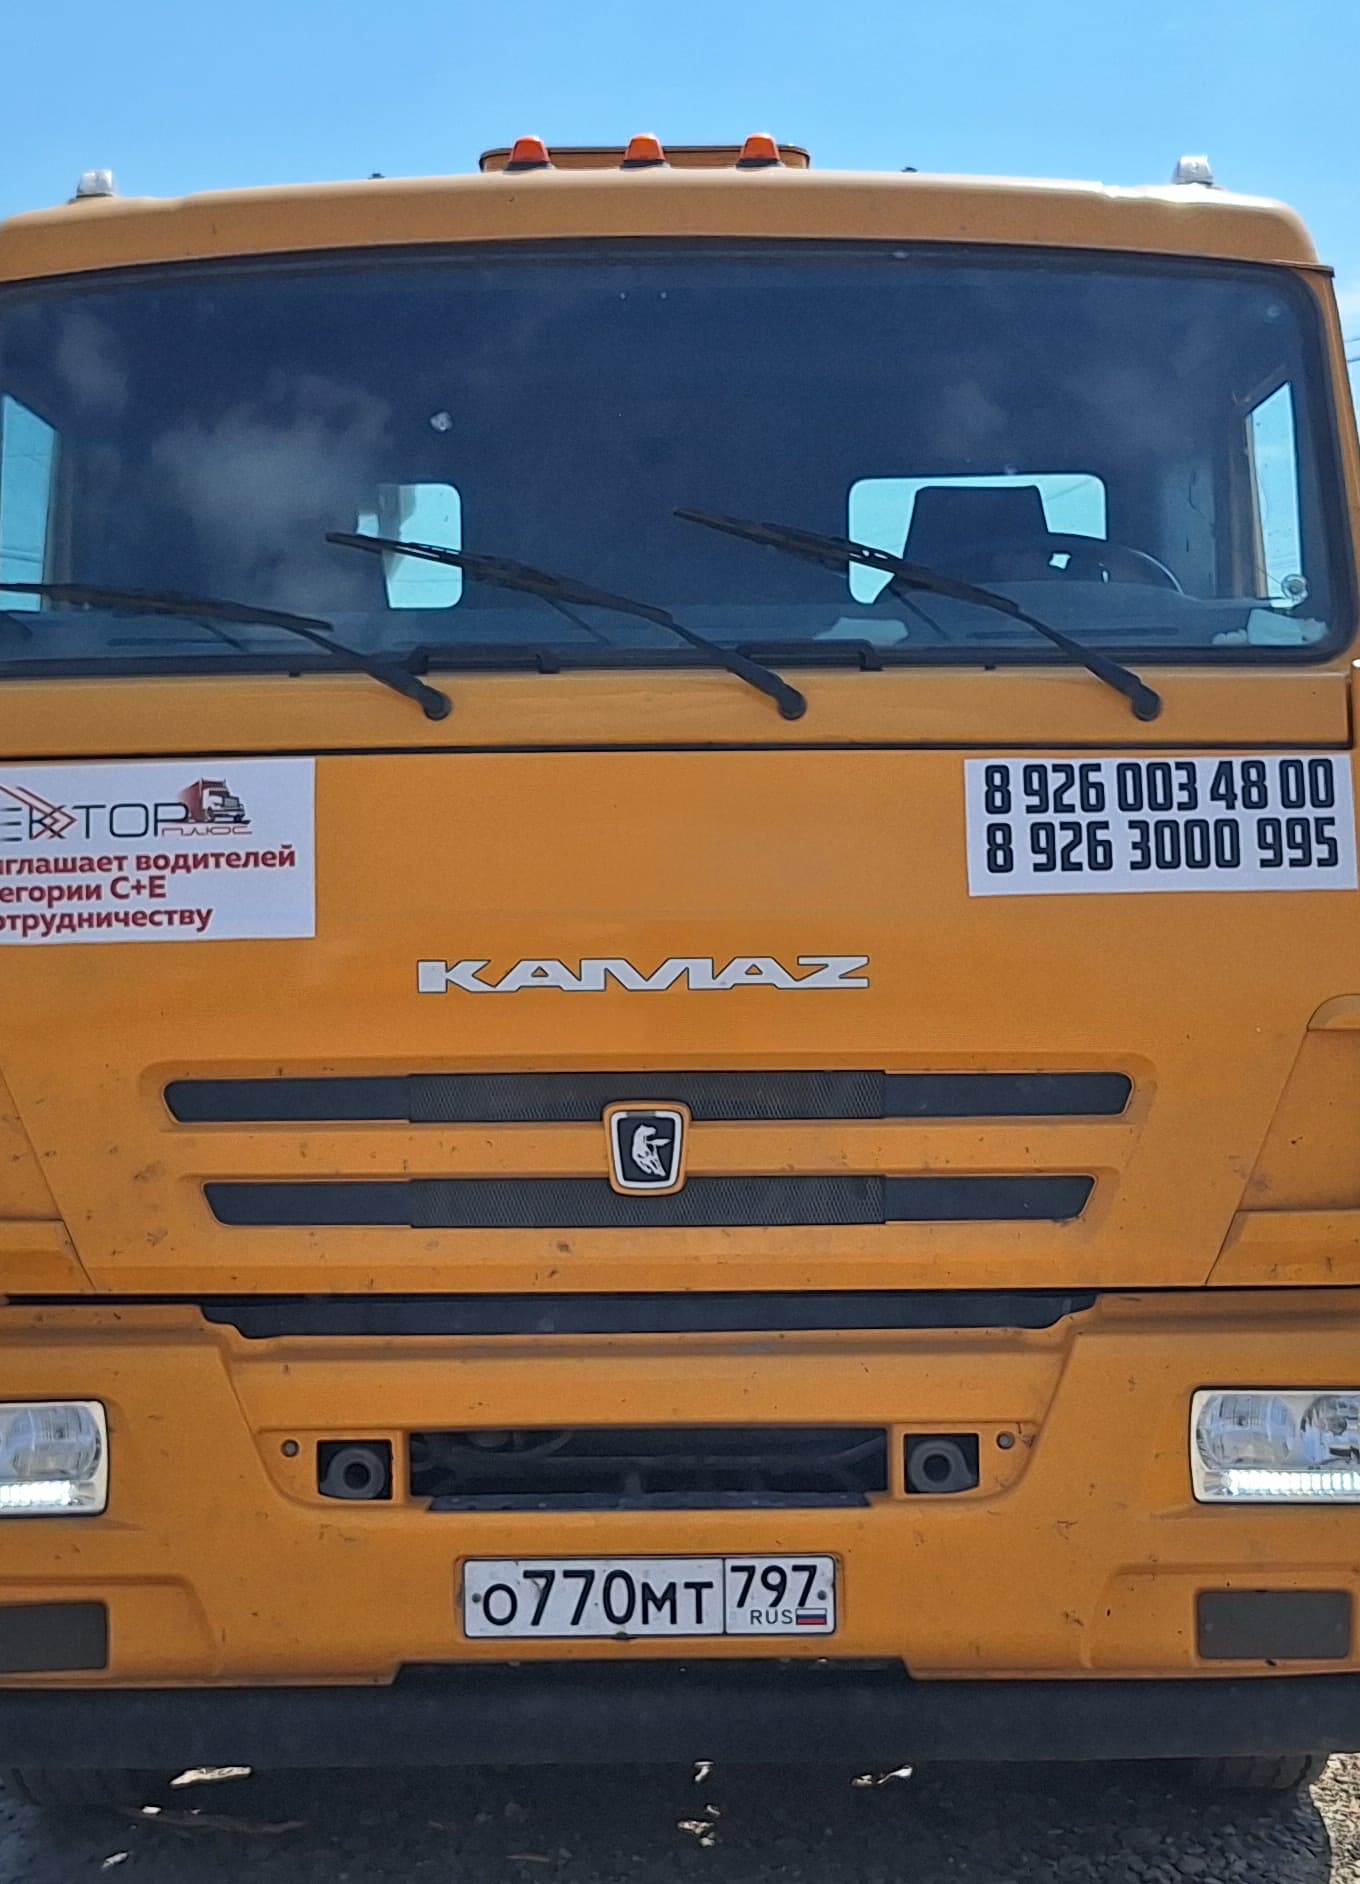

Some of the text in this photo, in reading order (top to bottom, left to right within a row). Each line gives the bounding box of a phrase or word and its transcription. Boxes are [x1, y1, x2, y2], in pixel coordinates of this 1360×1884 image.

[985, 758, 1335, 814] 8 926 003 48 00
[136, 845, 296, 873] водителей
[986, 816, 1338, 873] 8 926 3000 995
[417, 956, 869, 993] KAMAZ
[731, 1564, 818, 1608] 797
[751, 1610, 793, 1625] RUS
